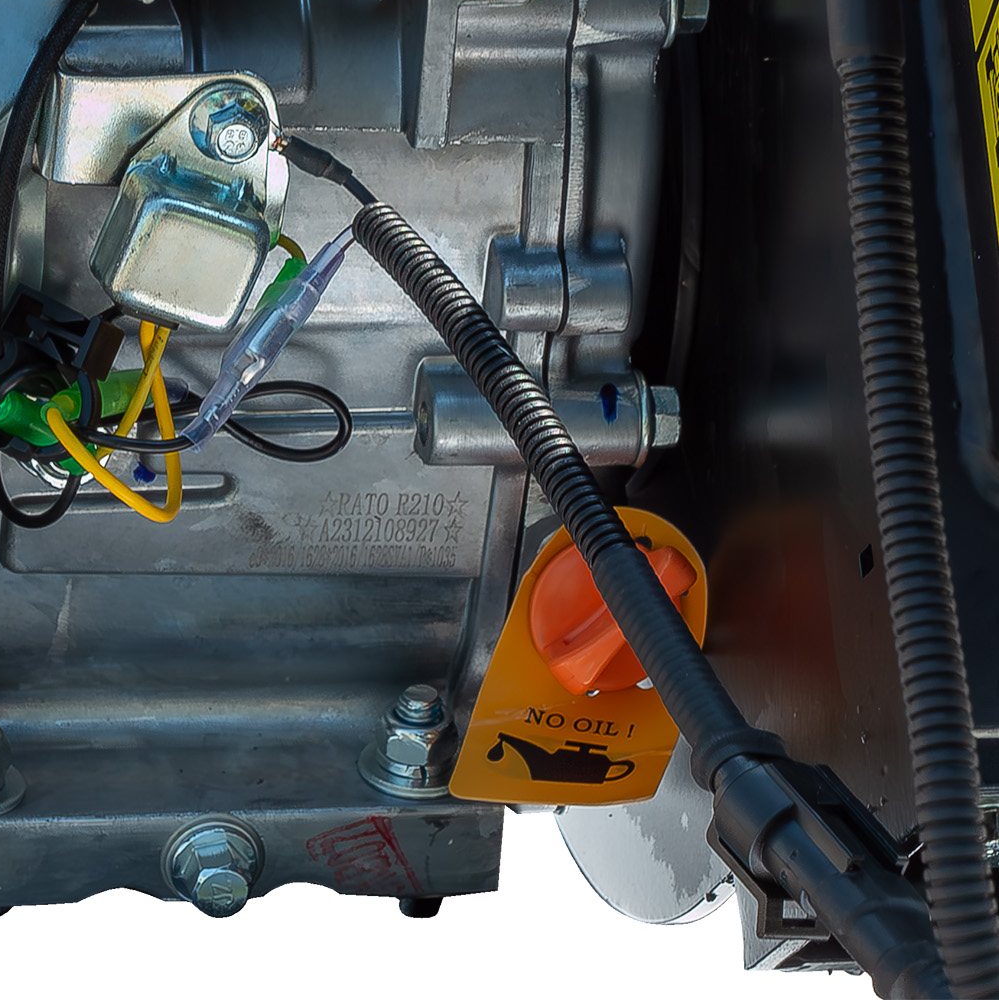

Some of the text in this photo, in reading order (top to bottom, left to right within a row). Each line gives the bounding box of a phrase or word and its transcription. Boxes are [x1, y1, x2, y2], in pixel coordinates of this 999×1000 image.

[338, 492, 444, 517] RATO R210
[524, 707, 565, 728] NO
[573, 718, 619, 737] OIL
